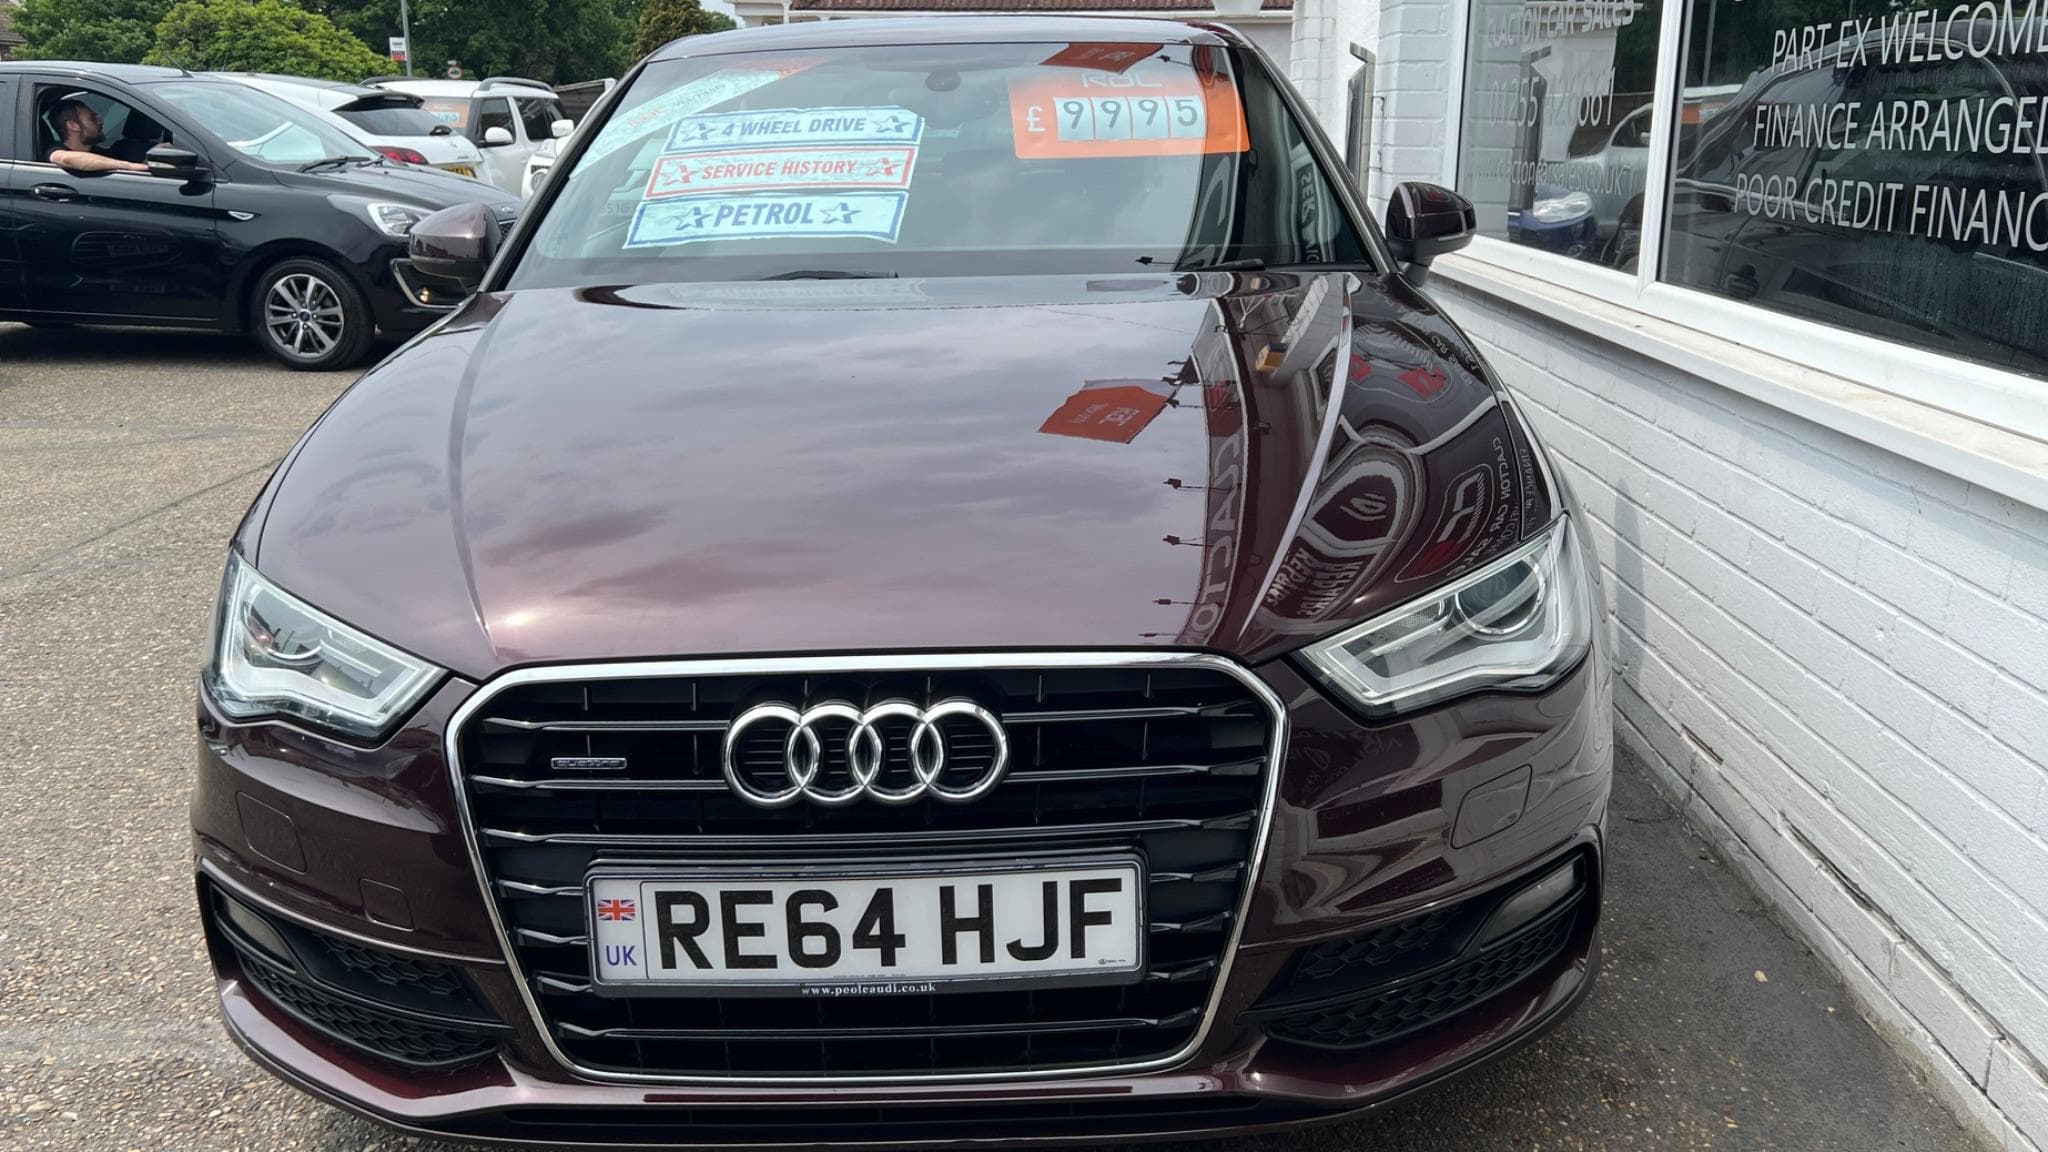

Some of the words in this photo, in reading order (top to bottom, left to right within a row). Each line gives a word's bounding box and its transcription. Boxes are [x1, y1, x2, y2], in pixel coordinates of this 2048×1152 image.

[1547, 1, 1576, 37] CAR
[1581, 0, 1635, 32] SALES
[1772, 23, 1832, 72] PART
[1836, 17, 1873, 68] EX
[721, 122, 735, 137] 4
[739, 119, 802, 136] WHEEL
[808, 117, 866, 133] DRIVE
[1026, 105, 1045, 132] £
[1753, 102, 1861, 149] FINANCE
[701, 161, 776, 180] SERVICE
[780, 160, 858, 176] HISTORY
[713, 202, 813, 228] PETROL
[1734, 173, 1797, 221] POOR
[1805, 178, 1903, 232] CREDIT
[654, 887, 906, 971] RE64
[938, 877, 1122, 966] HJF
[606, 945, 637, 966] UK
[801, 982, 936, 997] www.pooleaudi.co.uk
